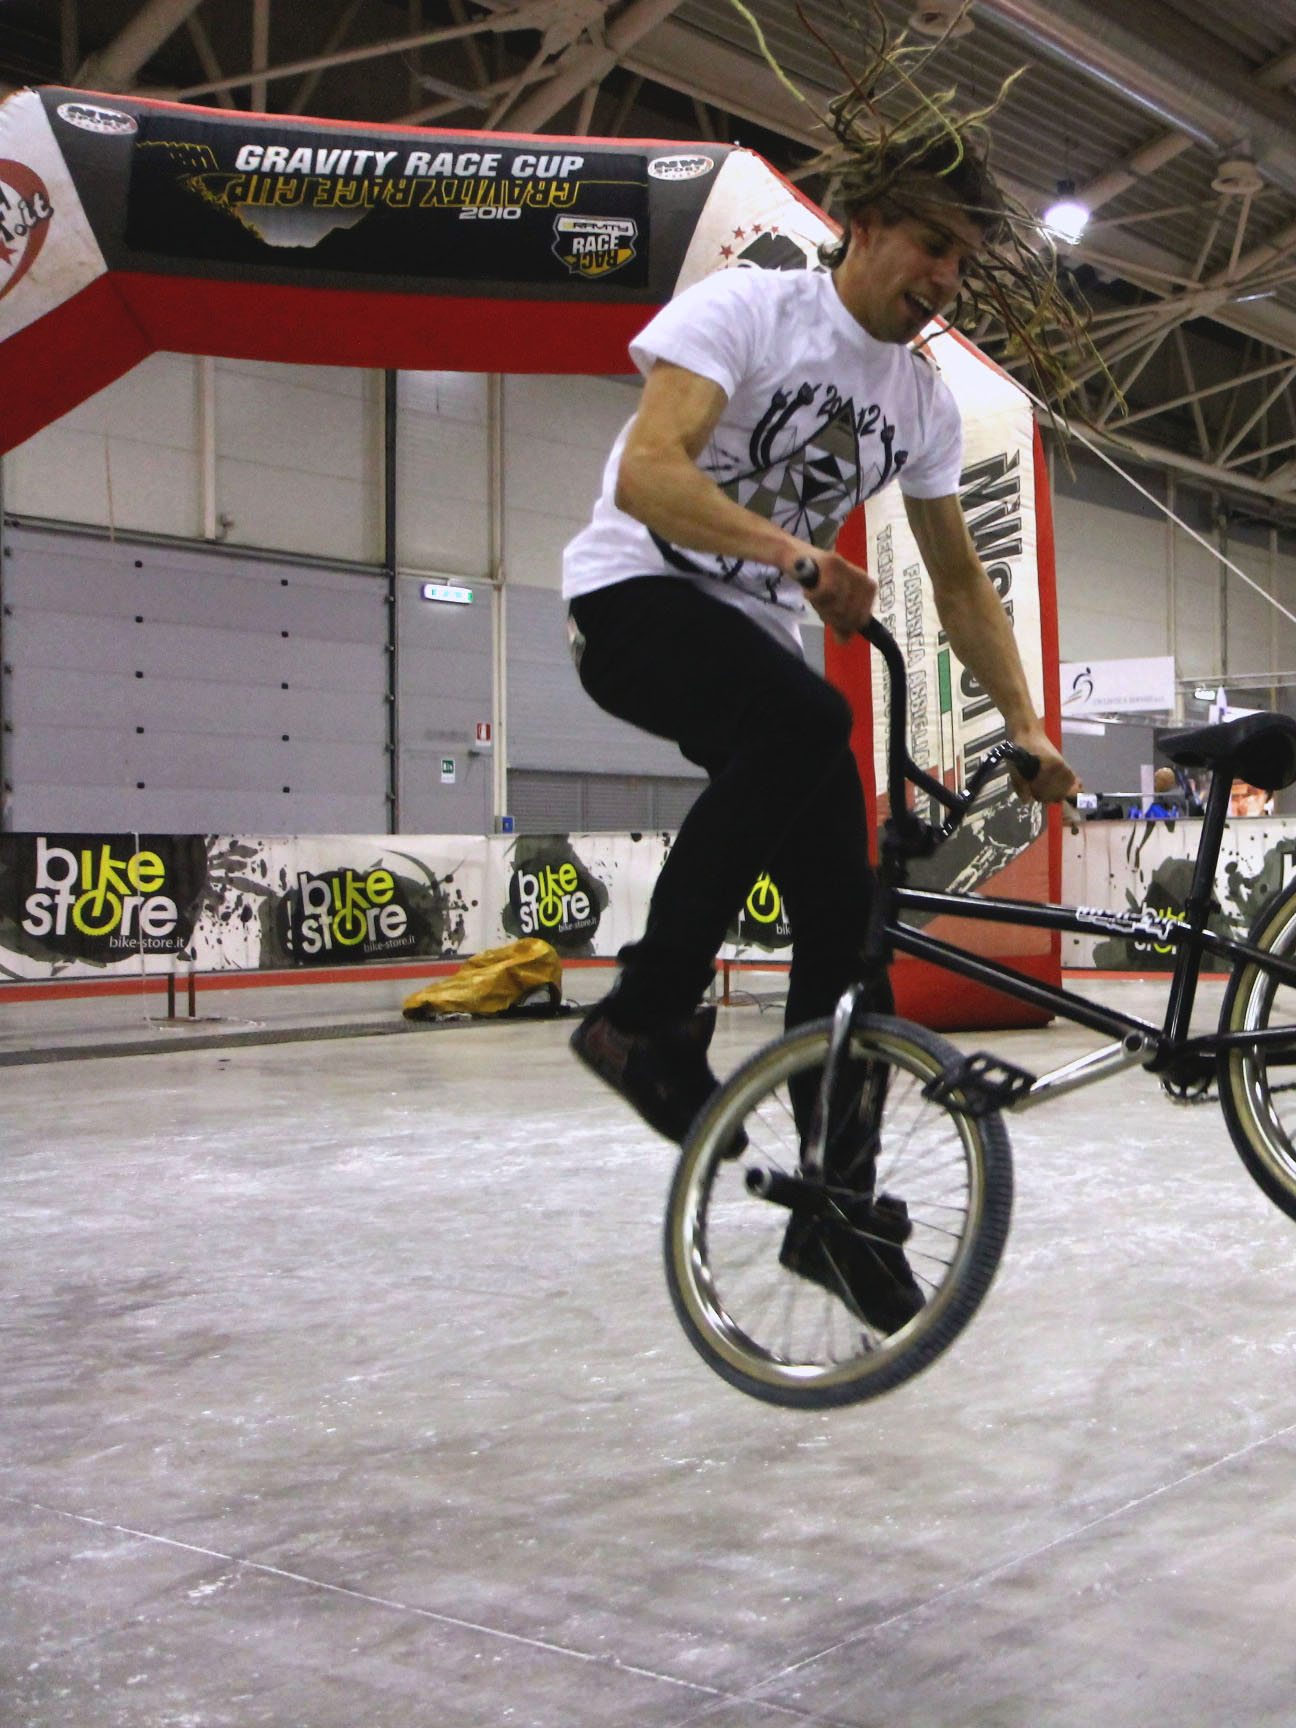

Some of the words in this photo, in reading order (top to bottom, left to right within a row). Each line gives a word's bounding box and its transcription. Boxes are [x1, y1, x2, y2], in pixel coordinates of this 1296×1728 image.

[235, 144, 398, 176] GRAVITY
[404, 151, 502, 177] RACE
[511, 154, 585, 178] CUP
[459, 206, 522, 220] 2010
[572, 234, 620, 255] RACE
[857, 404, 881, 437] 12
[877, 524, 896, 613] TECNICO
[903, 563, 926, 668] FABBRICA
[36, 837, 166, 893] bike
[518, 863, 578, 899] bike
[300, 868, 395, 915] bike
[22, 890, 179, 937] store
[302, 904, 408, 954] store
[520, 890, 591, 934] store
[109, 936, 185, 950] bike-store.it
[364, 935, 415, 953] bike-store.it
